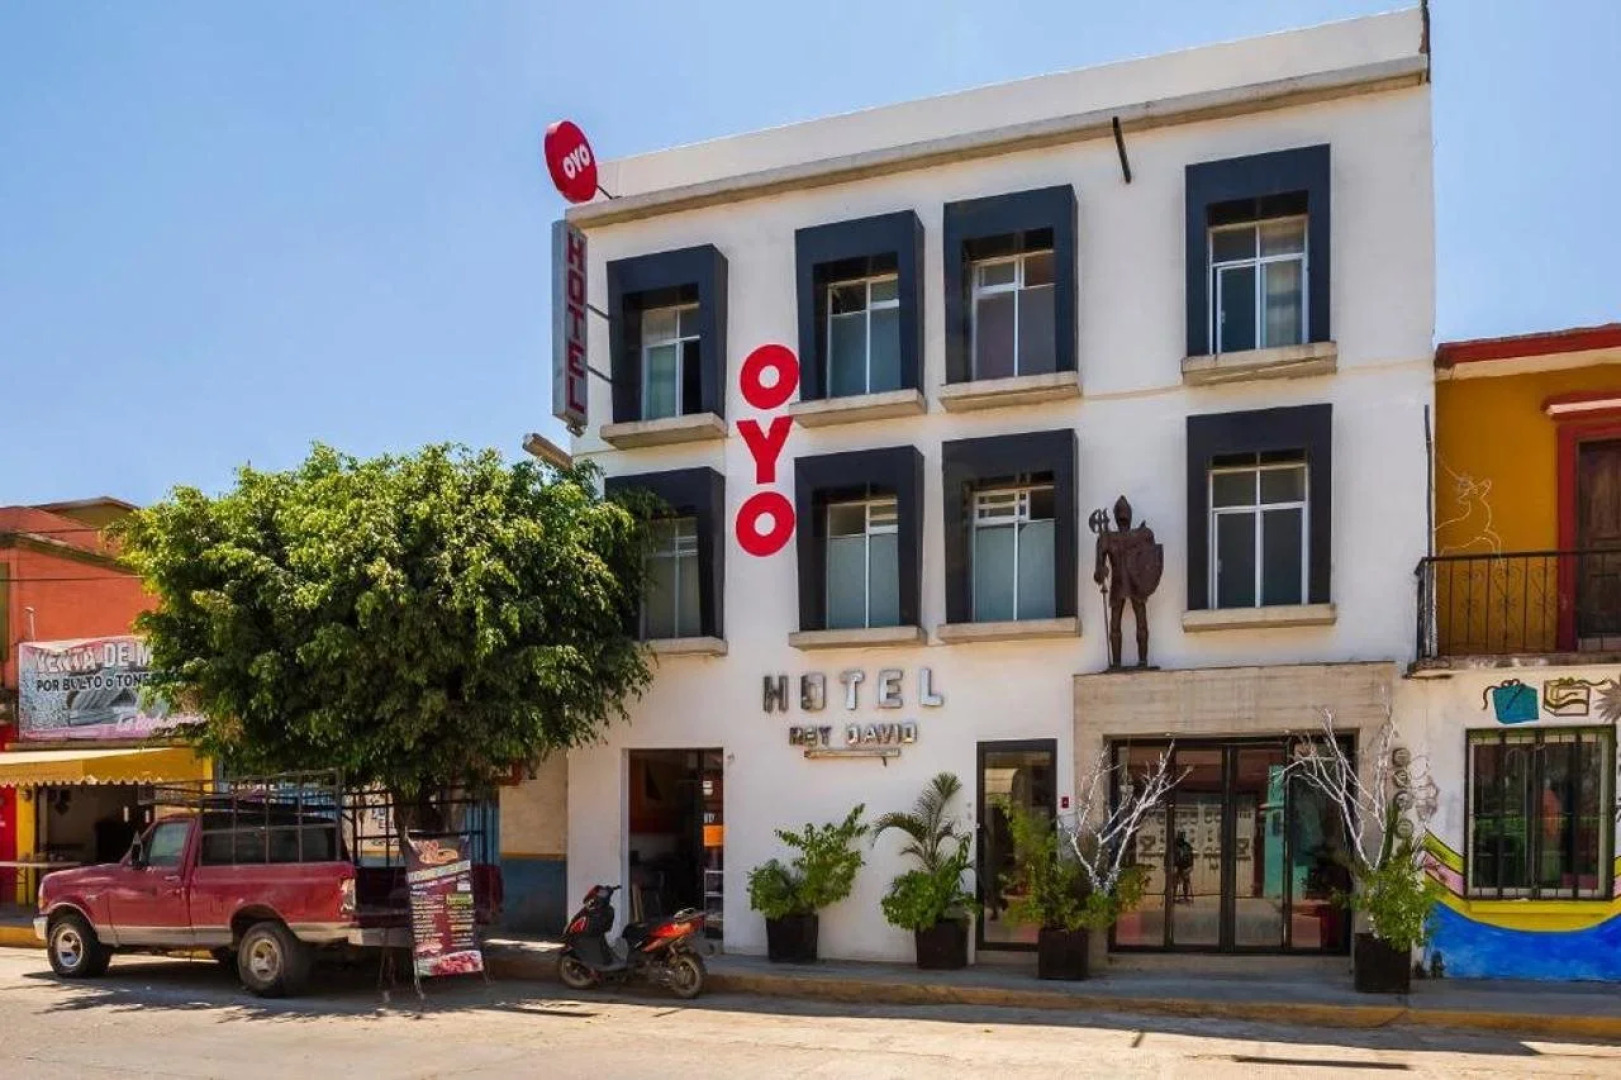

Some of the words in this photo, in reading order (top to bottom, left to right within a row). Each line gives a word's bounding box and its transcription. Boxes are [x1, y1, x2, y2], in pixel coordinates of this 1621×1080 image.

[562, 143, 590, 180] OYO
[568, 229, 585, 415] HOTEL
[734, 344, 799, 557] OYO
[104, 642, 130, 667] DE
[36, 679, 59, 692] POR
[62, 675, 102, 691] BULTO
[763, 668, 945, 713] HOTEL
[846, 722, 918, 746] DAVID
